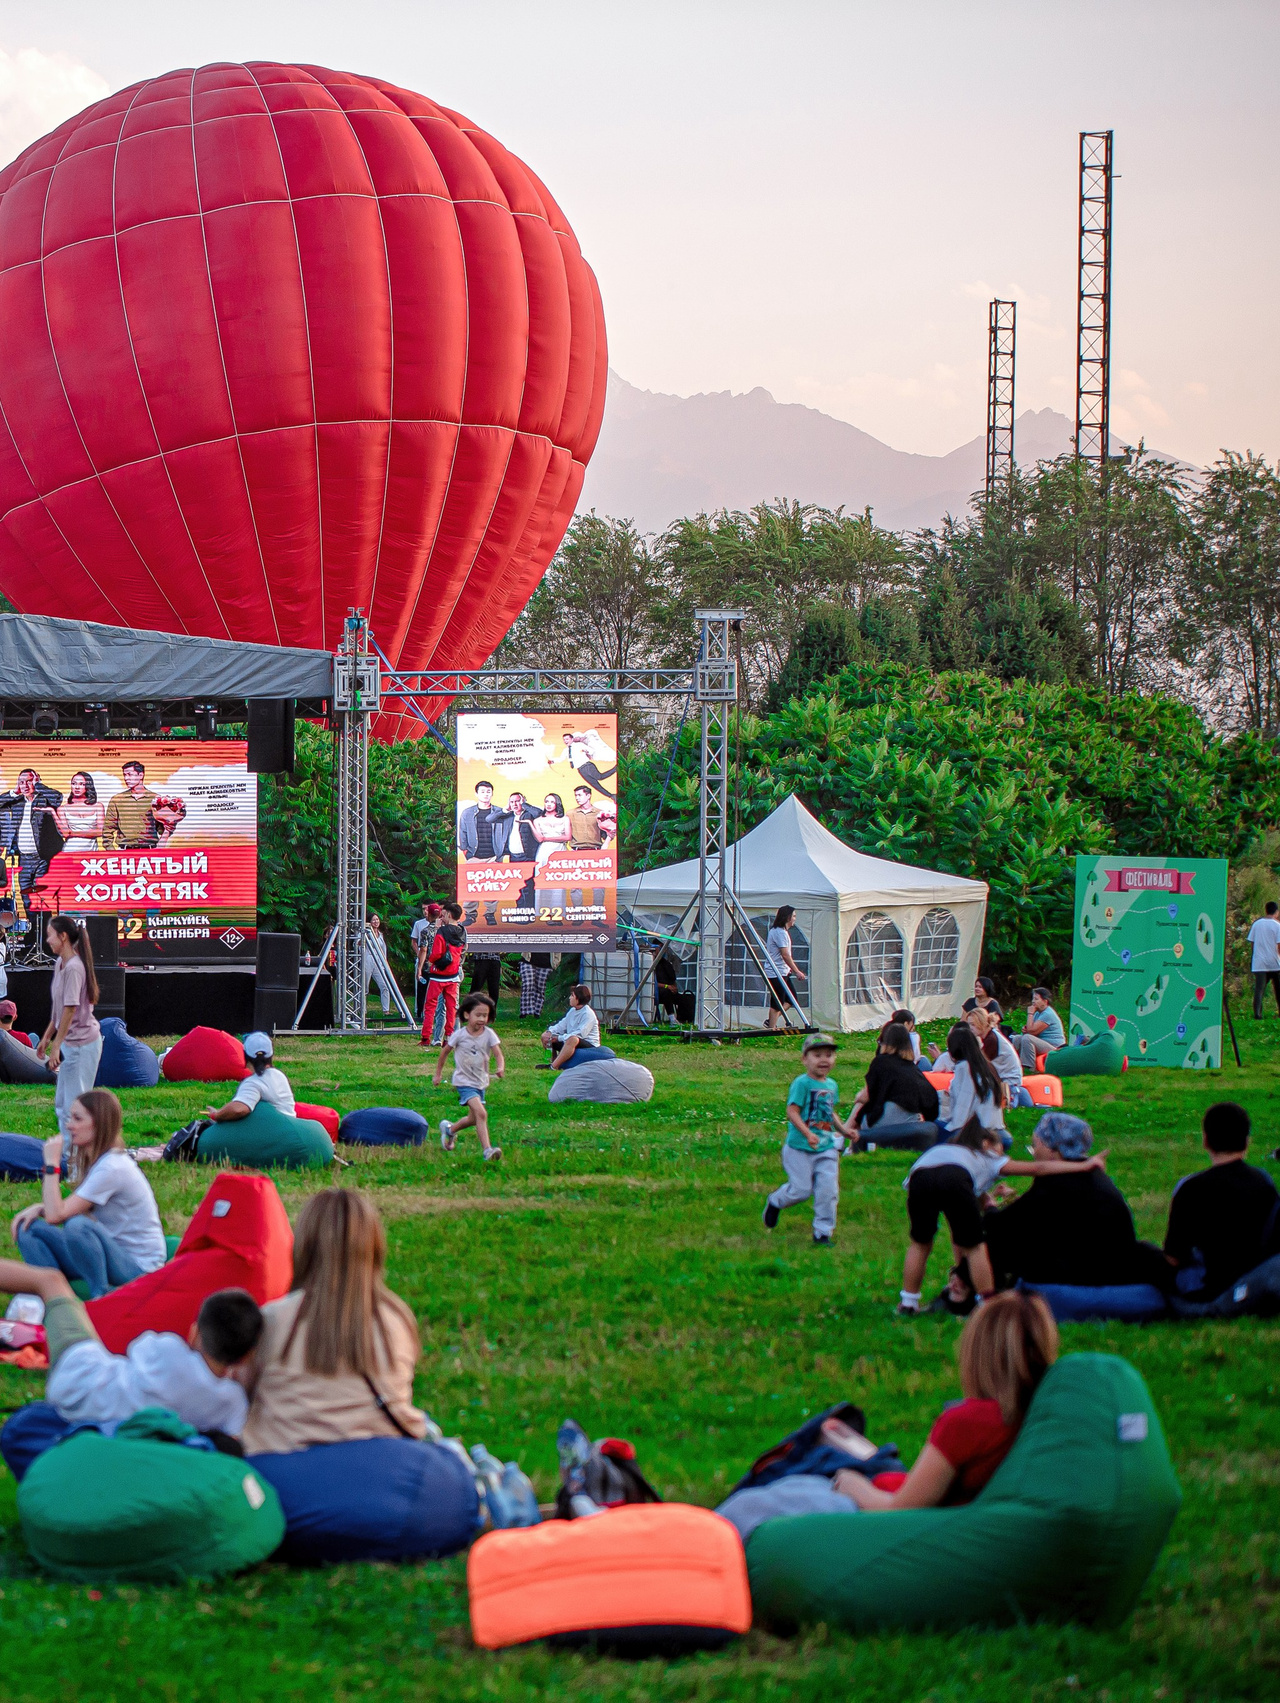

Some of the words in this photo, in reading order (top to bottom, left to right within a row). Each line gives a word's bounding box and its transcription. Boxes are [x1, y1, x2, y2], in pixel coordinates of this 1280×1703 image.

[80, 852, 208, 876] ЖЕНАТЫЙ
[548, 857, 612, 869] ЖЕНАТЫЙ
[545, 869, 612, 881] ХОЛОСТЯК
[1125, 871, 1174, 888] ФЕСТИВАЛЬ
[74, 877, 209, 902] ХОЛОСТЯК
[467, 881, 510, 893] КҮЙЕУ
[501, 907, 536, 915] КИНОДА
[539, 907, 563, 921] 22
[565, 905, 606, 914] ҚЫРКҮЙЕК
[566, 913, 606, 921] СЕНТЯБРЯ
[148, 915, 210, 927] ҚЫРКҮЙЕК
[149, 928, 210, 939] СЕНТЯБРЯ
